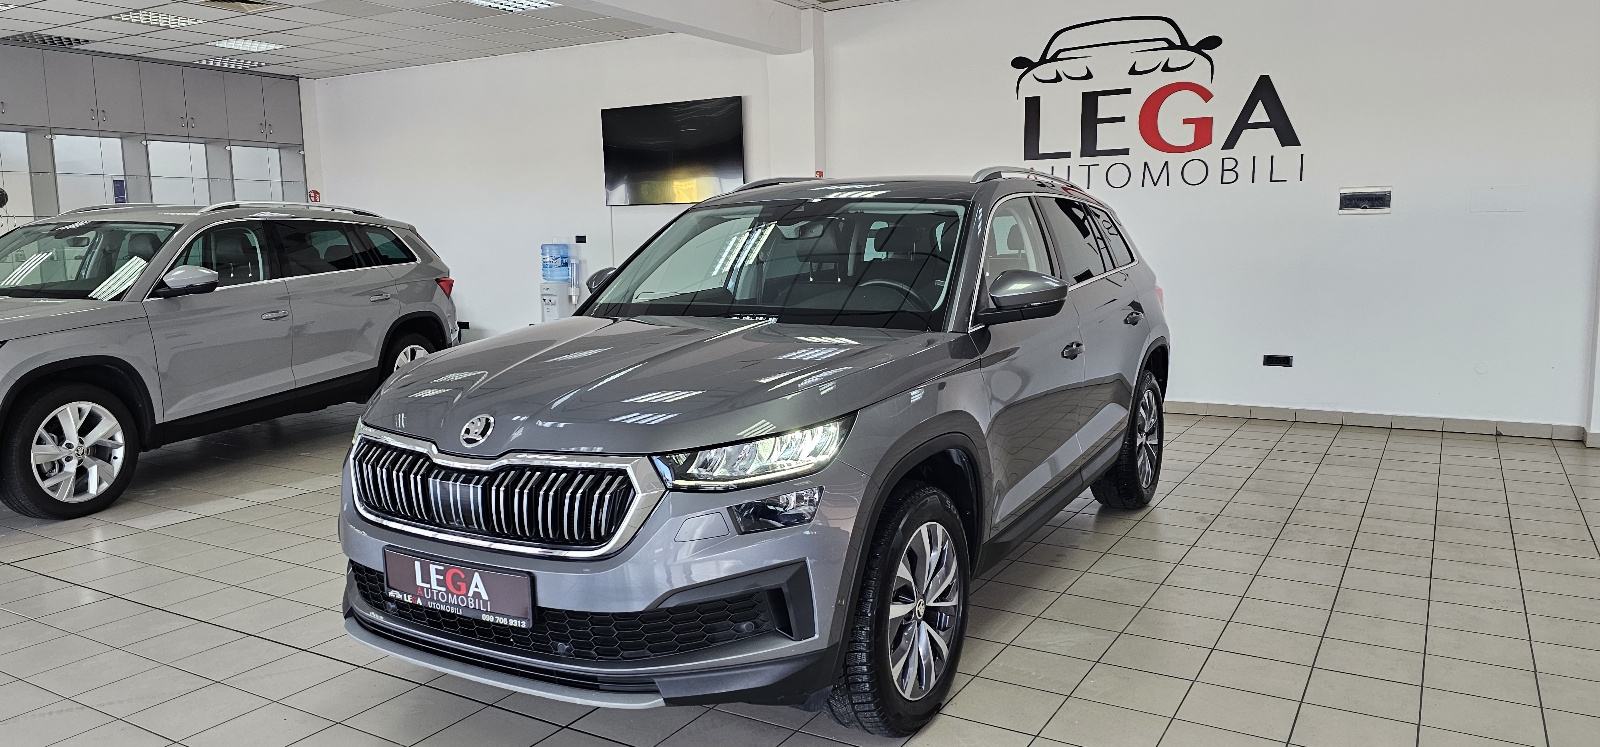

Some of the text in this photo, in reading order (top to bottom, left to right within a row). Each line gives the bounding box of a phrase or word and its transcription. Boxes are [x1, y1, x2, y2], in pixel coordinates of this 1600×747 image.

[1024, 74, 1301, 161] LEGA
[1027, 153, 1305, 190] UTOMOBILI
[414, 560, 489, 600] LEGA
[403, 593, 422, 606] LEGA
[416, 586, 491, 612] AUTOMOBILI
